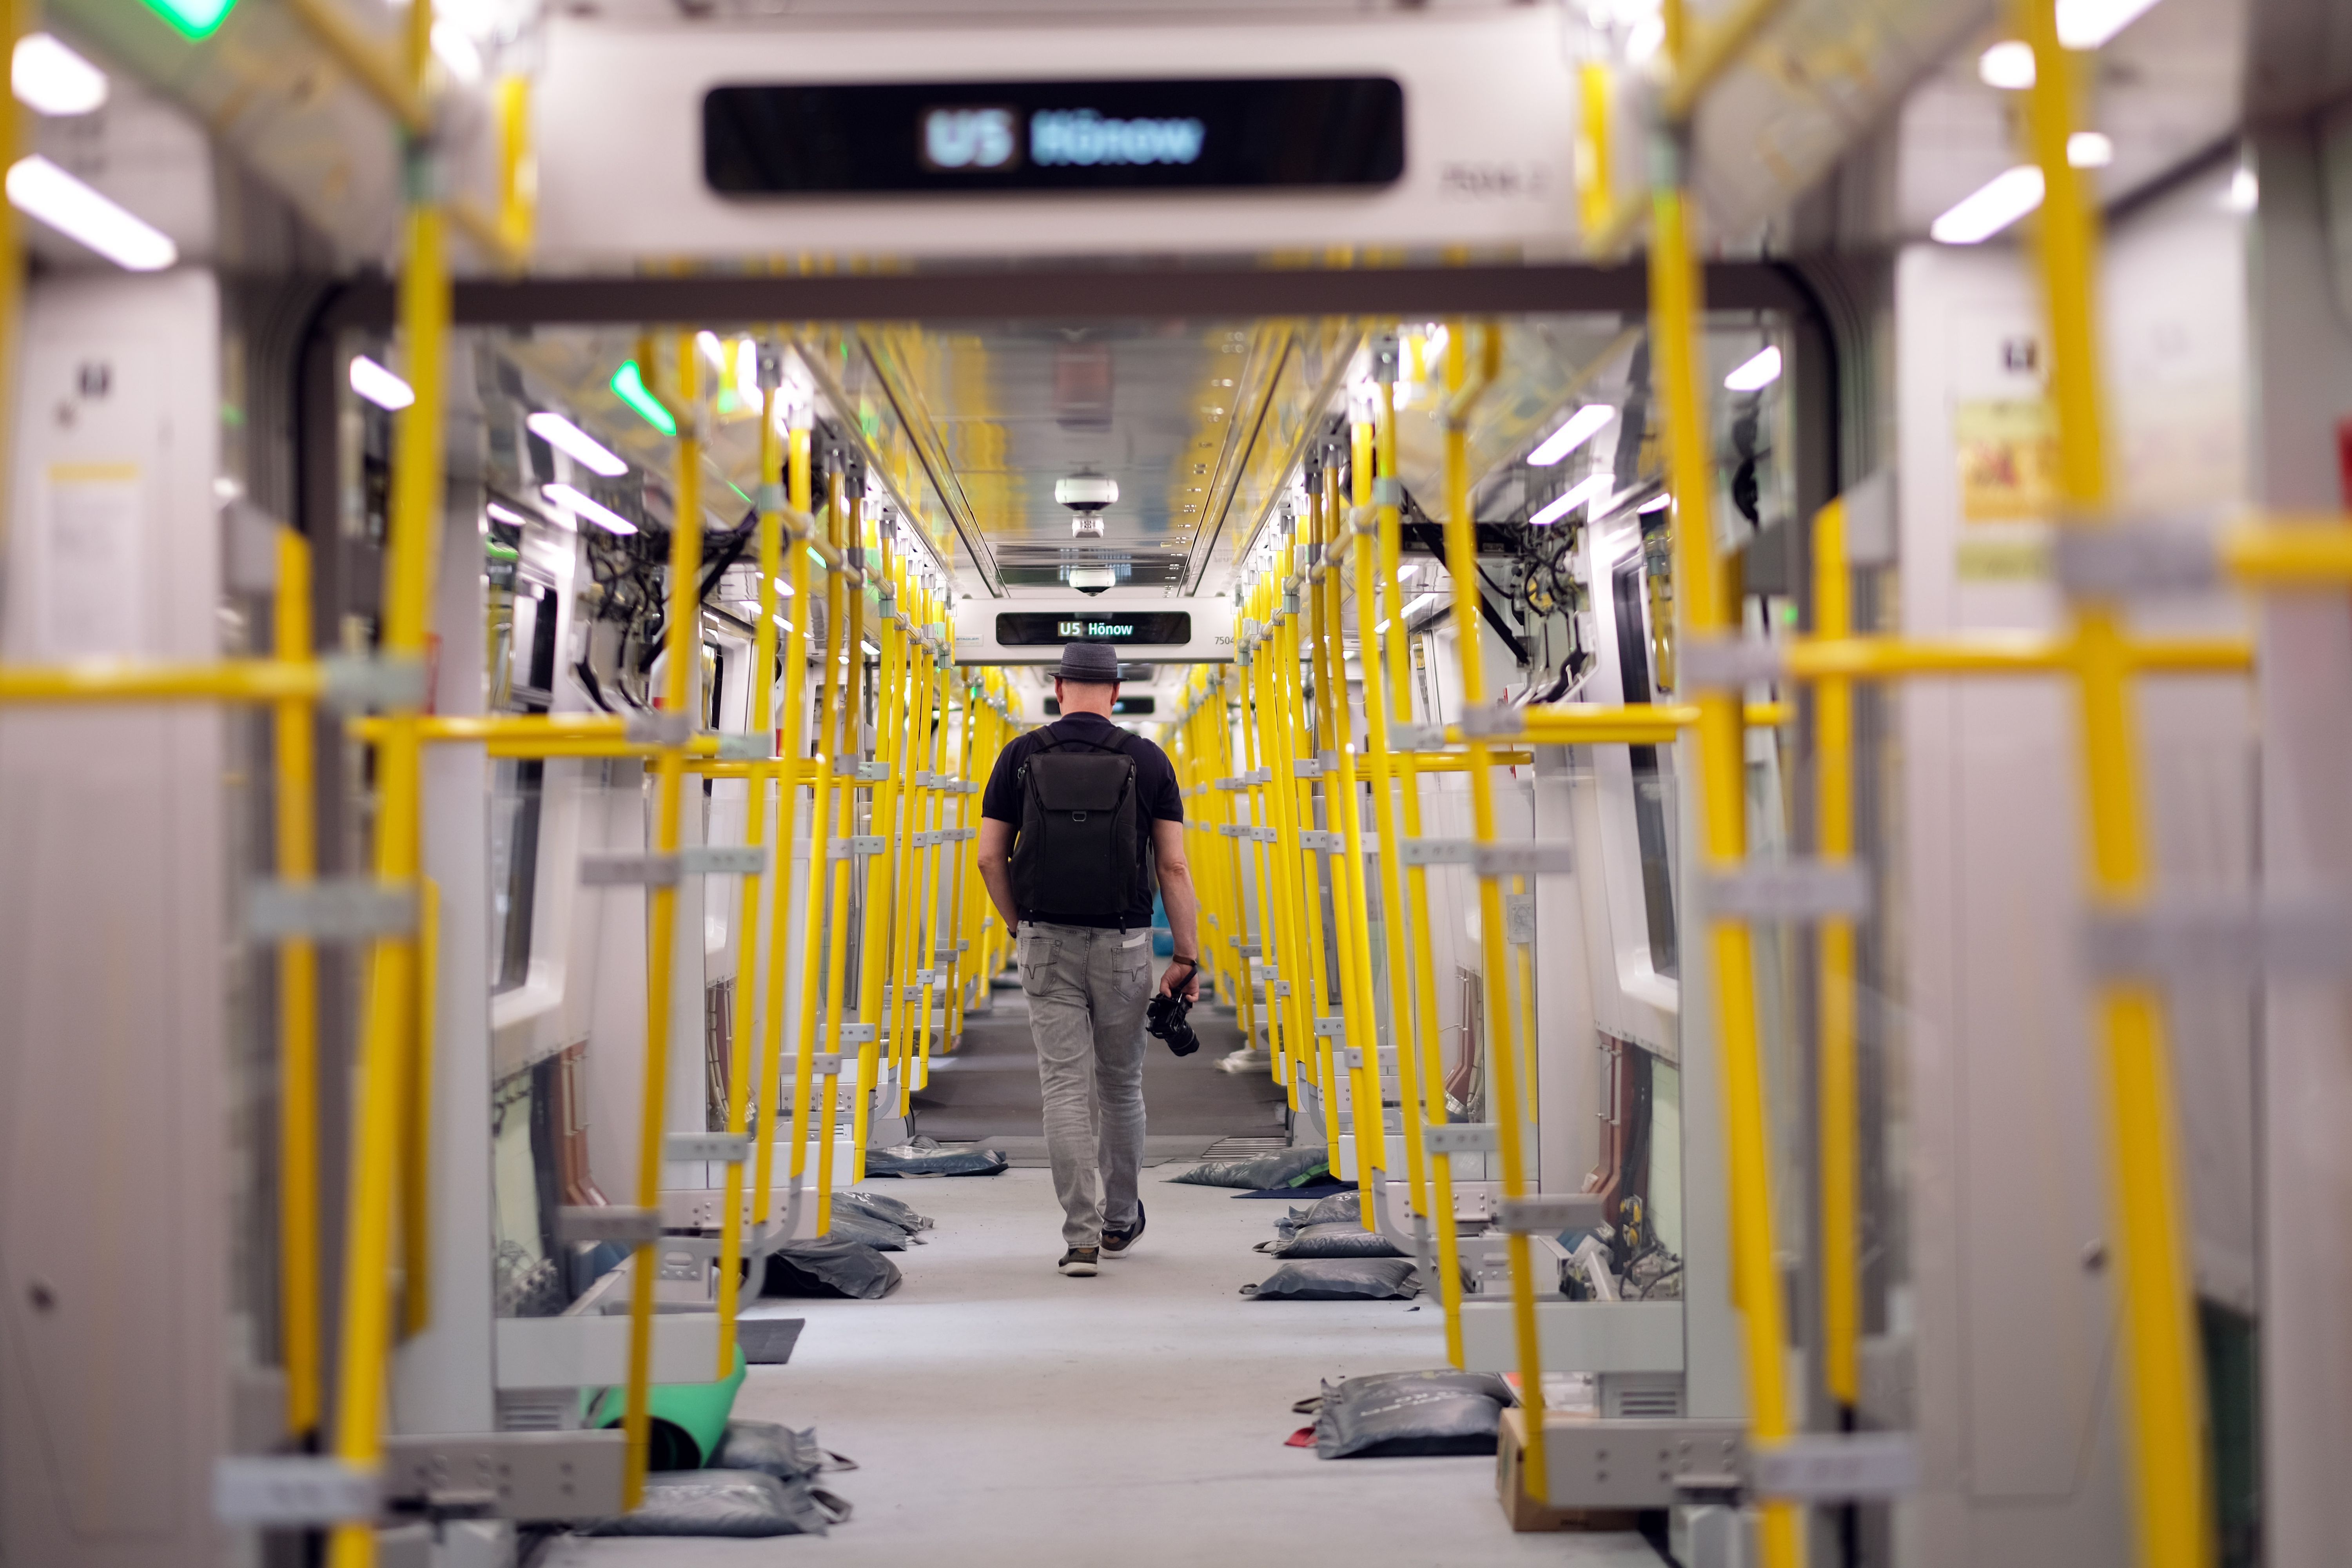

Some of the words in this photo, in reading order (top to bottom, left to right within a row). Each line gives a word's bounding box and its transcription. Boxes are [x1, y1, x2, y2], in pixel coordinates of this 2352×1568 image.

[926, 109, 1013, 167] U5
[1031, 108, 1205, 166] Hönow
[1060, 622, 1080, 635] U5
[1089, 622, 1132, 635] Hönow
